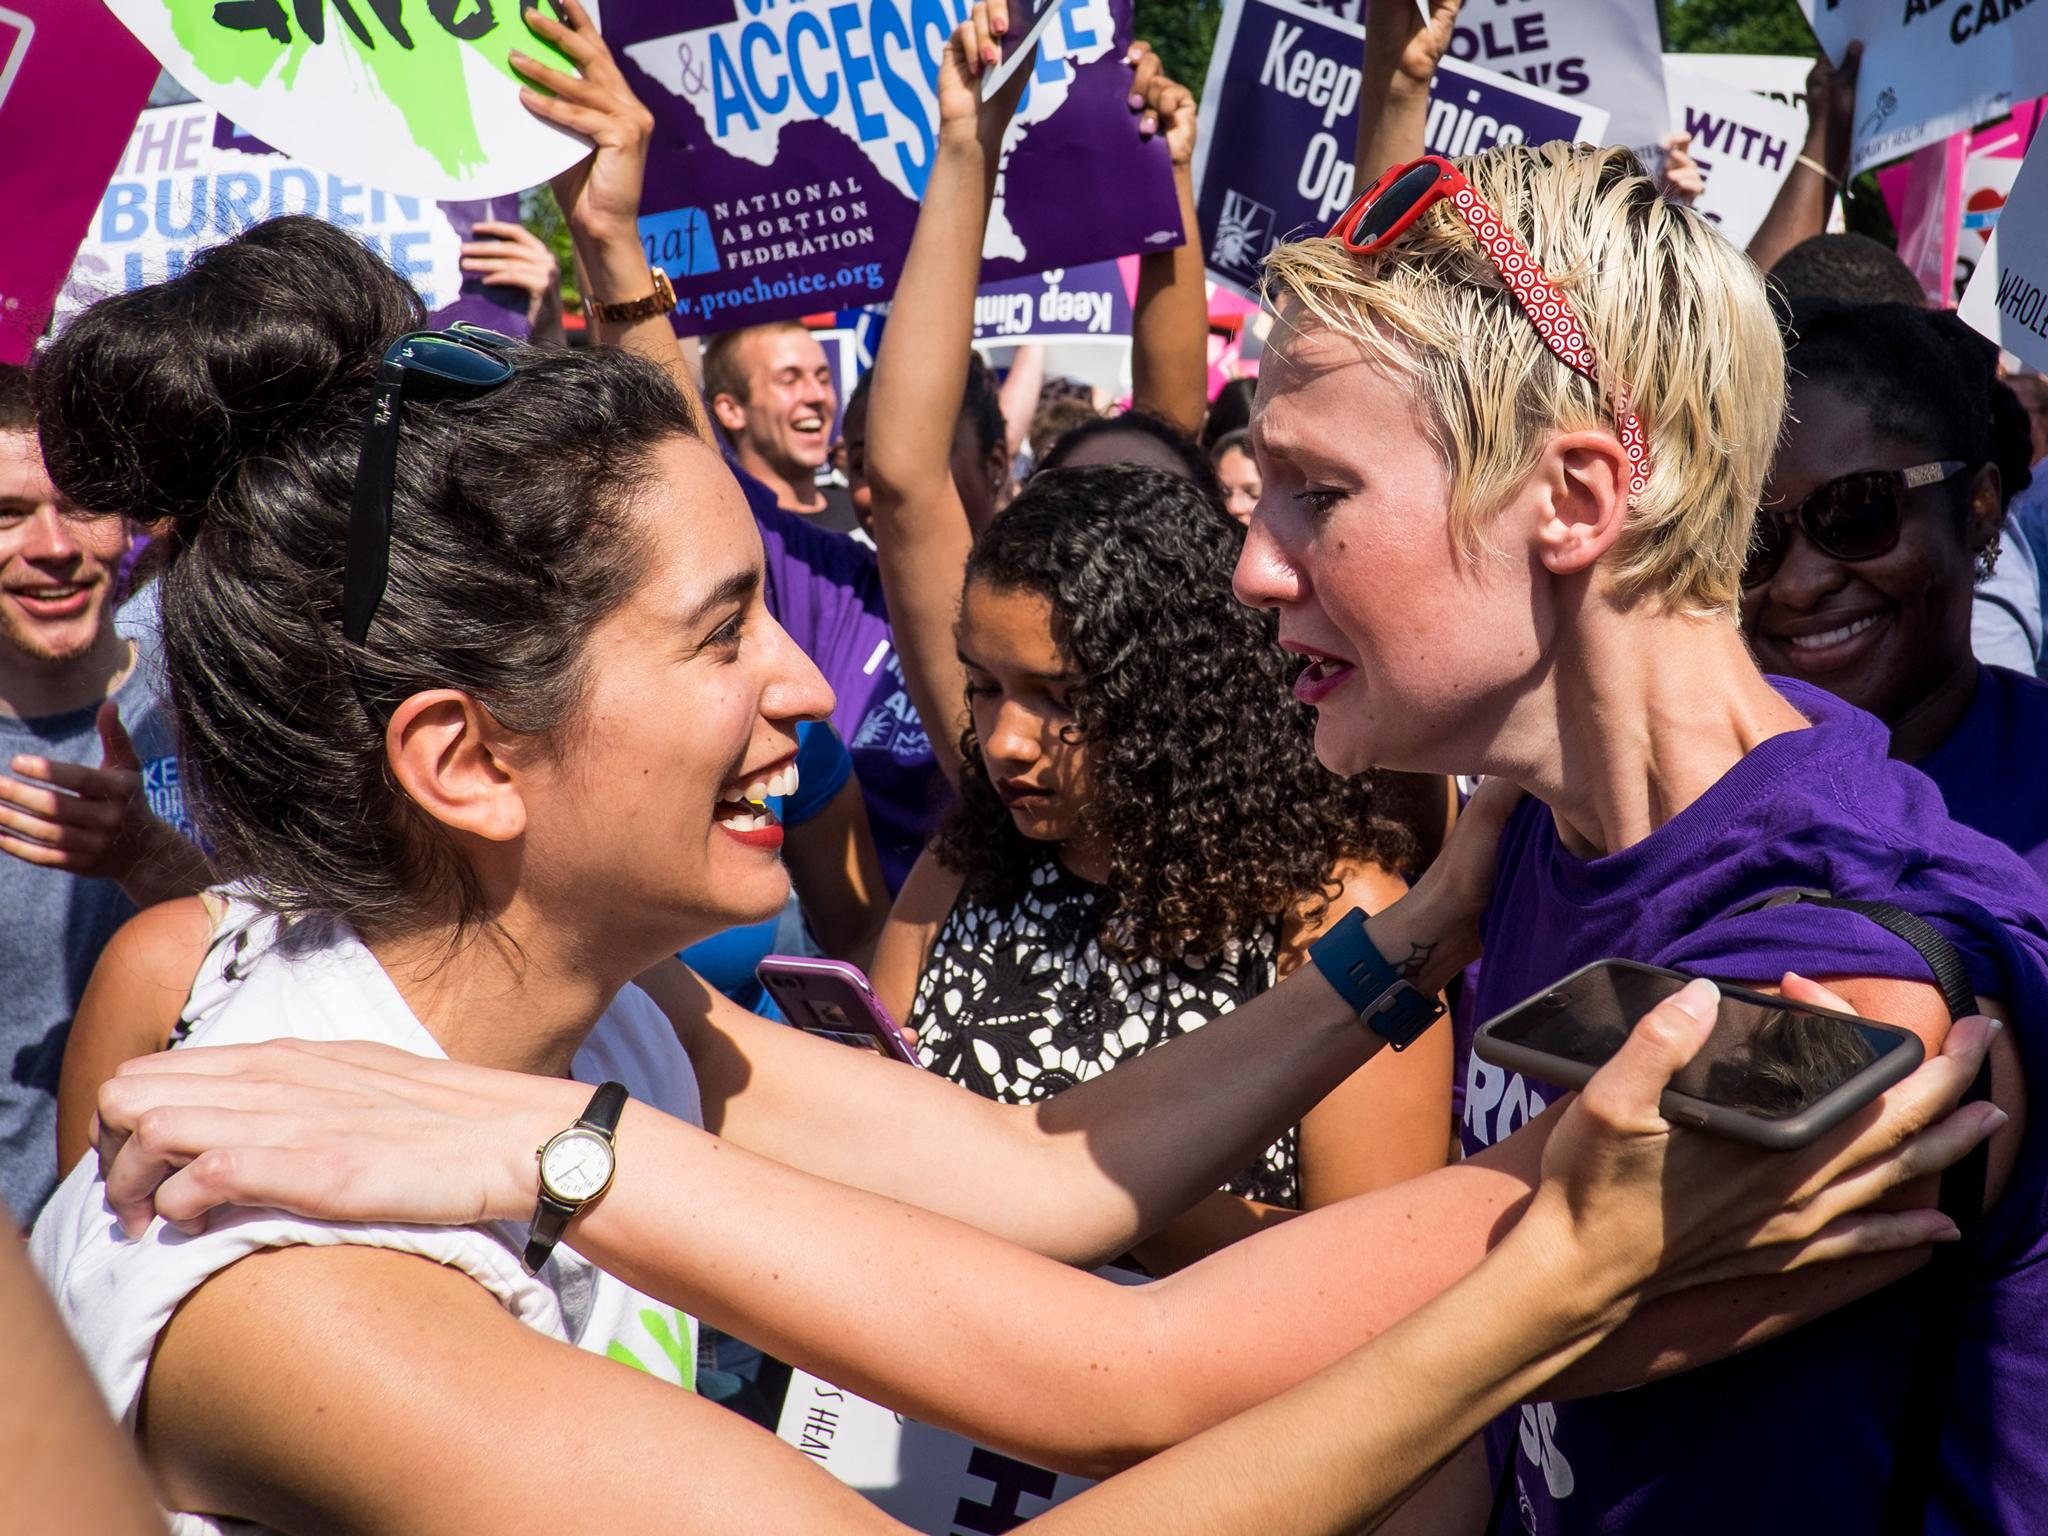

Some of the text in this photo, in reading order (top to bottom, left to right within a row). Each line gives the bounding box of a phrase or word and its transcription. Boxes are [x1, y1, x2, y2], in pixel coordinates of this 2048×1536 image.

[1448, 12, 1549, 62] OLE
[678, 0, 1098, 201] & ACCESSLE
[1259, 19, 1363, 129] Keep
[1685, 106, 1788, 172] WITH
[100, 166, 421, 244] BURDEN
[713, 176, 863, 220] NATIONAL
[1297, 131, 1356, 223] Op
[721, 200, 869, 246] ABORTION
[726, 226, 875, 270] FEDERATION
[673, 262, 886, 322] w.prochoice.org
[974, 285, 1113, 338] Keep Clini
